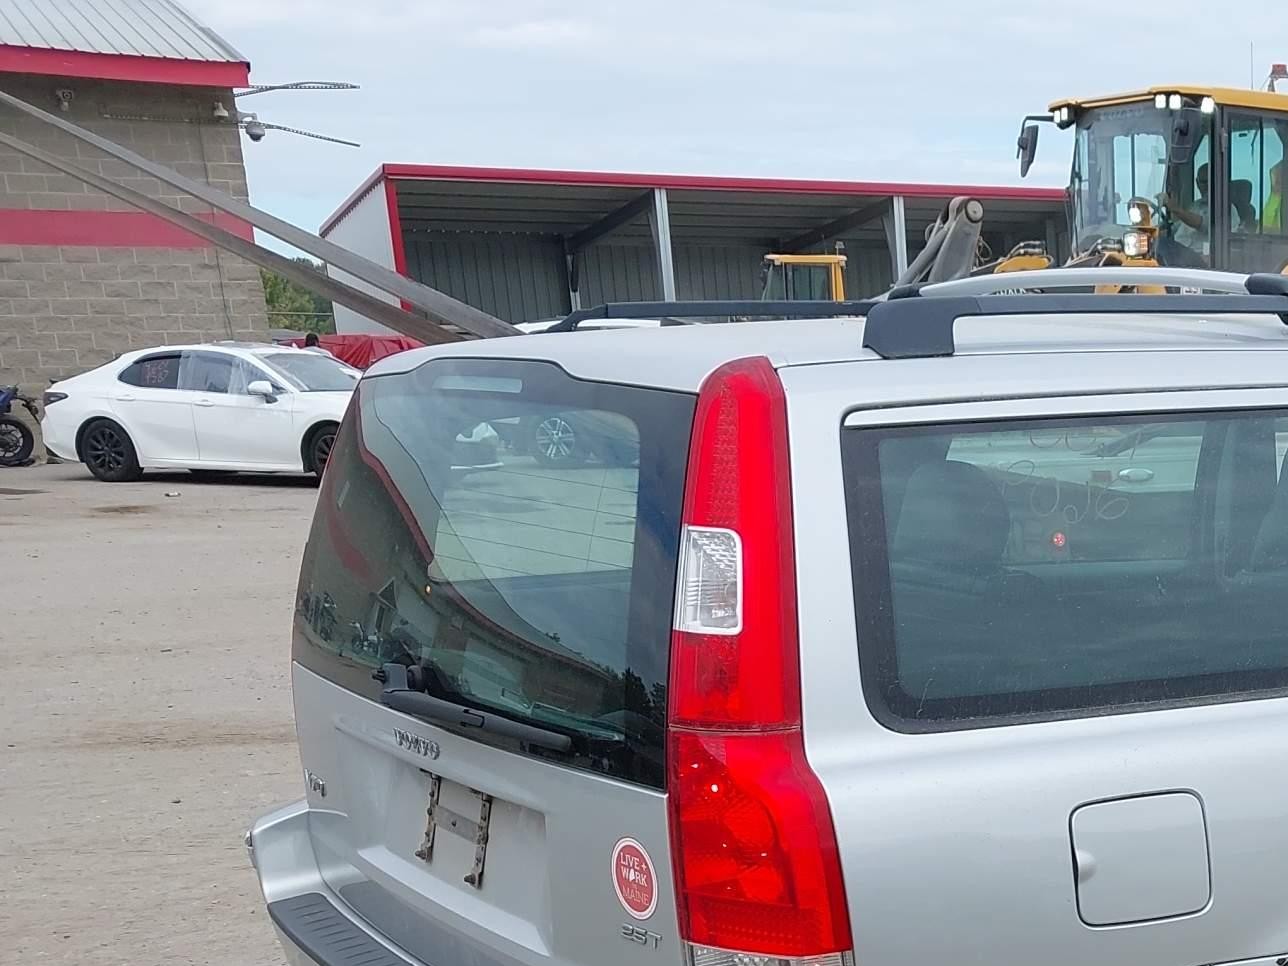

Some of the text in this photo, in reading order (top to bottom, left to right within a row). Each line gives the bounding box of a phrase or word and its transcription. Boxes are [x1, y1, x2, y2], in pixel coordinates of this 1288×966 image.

[393, 727, 441, 760] VOLVO
[620, 852, 640, 871] LIVE
[622, 885, 649, 906] MAINE
